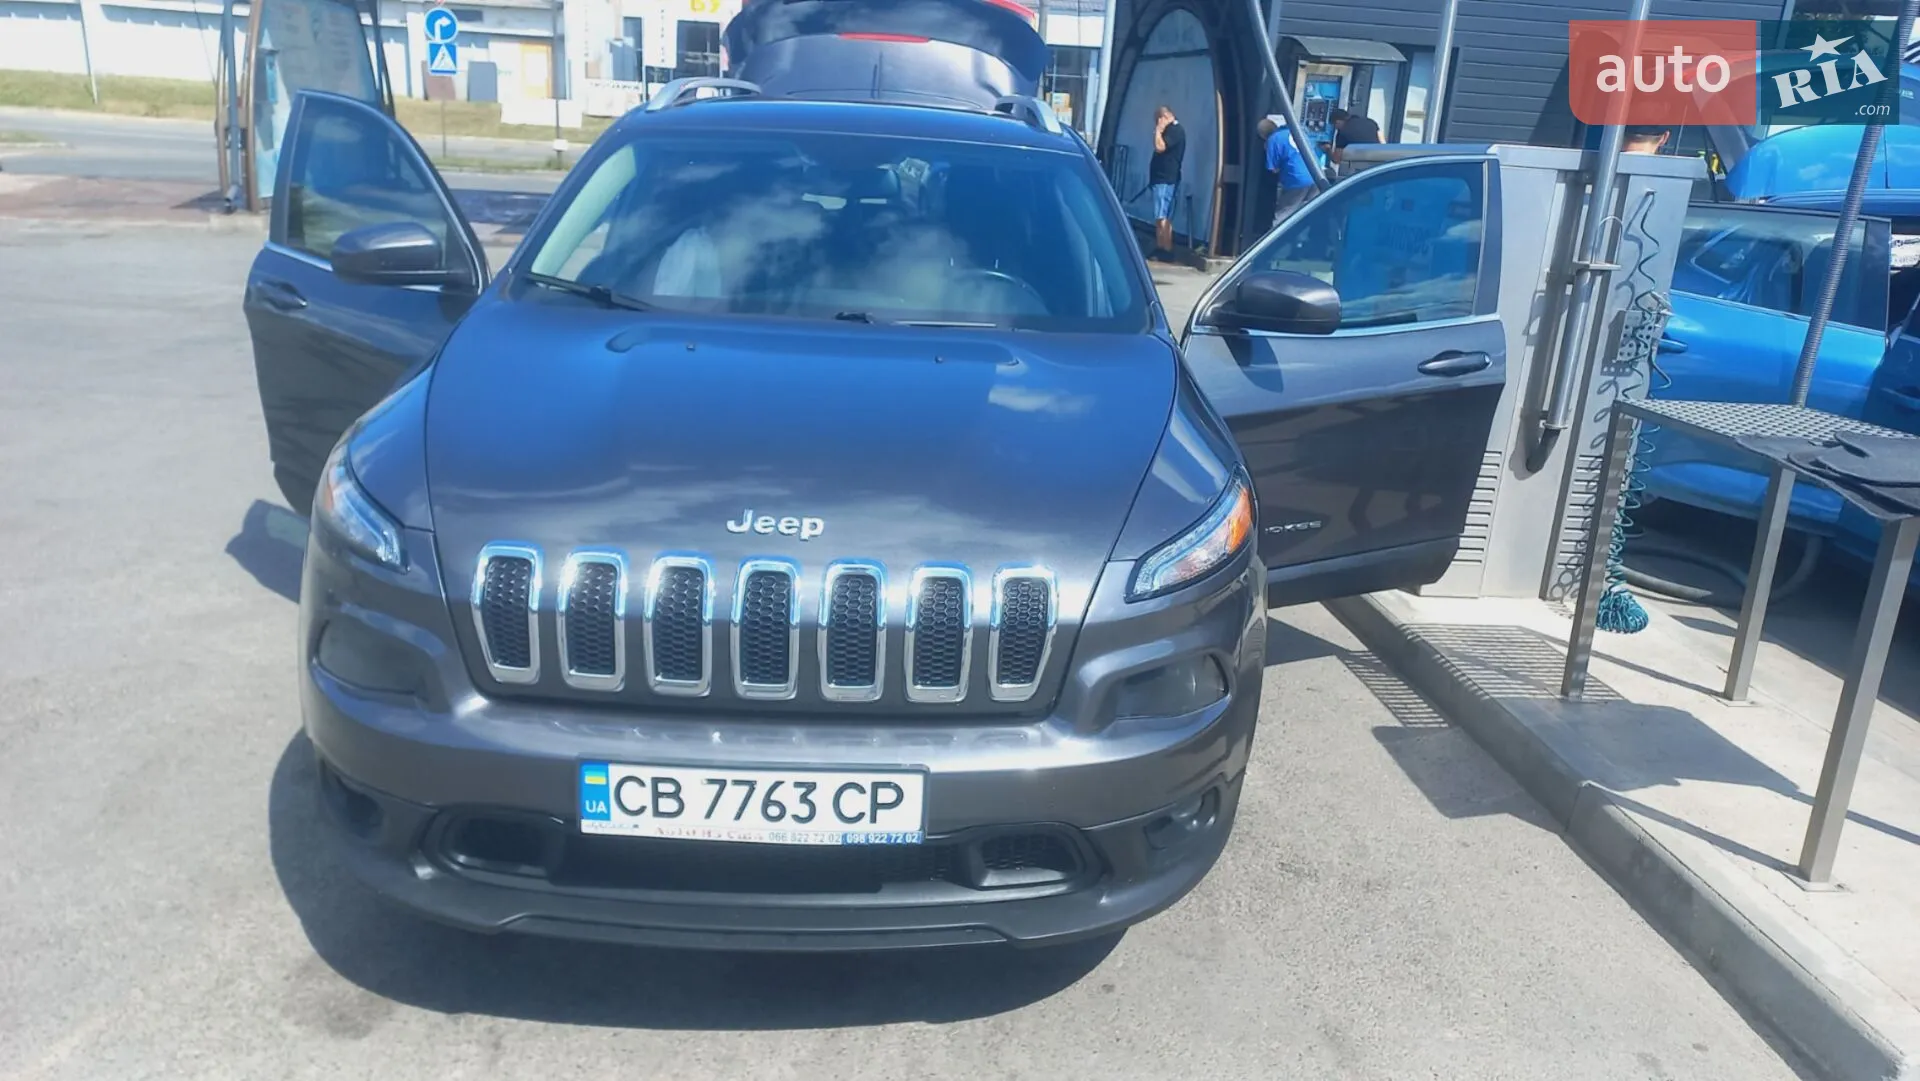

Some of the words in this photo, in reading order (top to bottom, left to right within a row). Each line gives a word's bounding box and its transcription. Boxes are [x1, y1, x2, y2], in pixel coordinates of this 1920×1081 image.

[726, 508, 825, 541] Jeep
[585, 799, 608, 814] UA
[613, 775, 685, 819] CB
[701, 777, 817, 824] 7763
[832, 781, 904, 825] CP
[868, 833, 887, 844] 922
[890, 834, 902, 844] 72
[905, 833, 918, 844] 02
